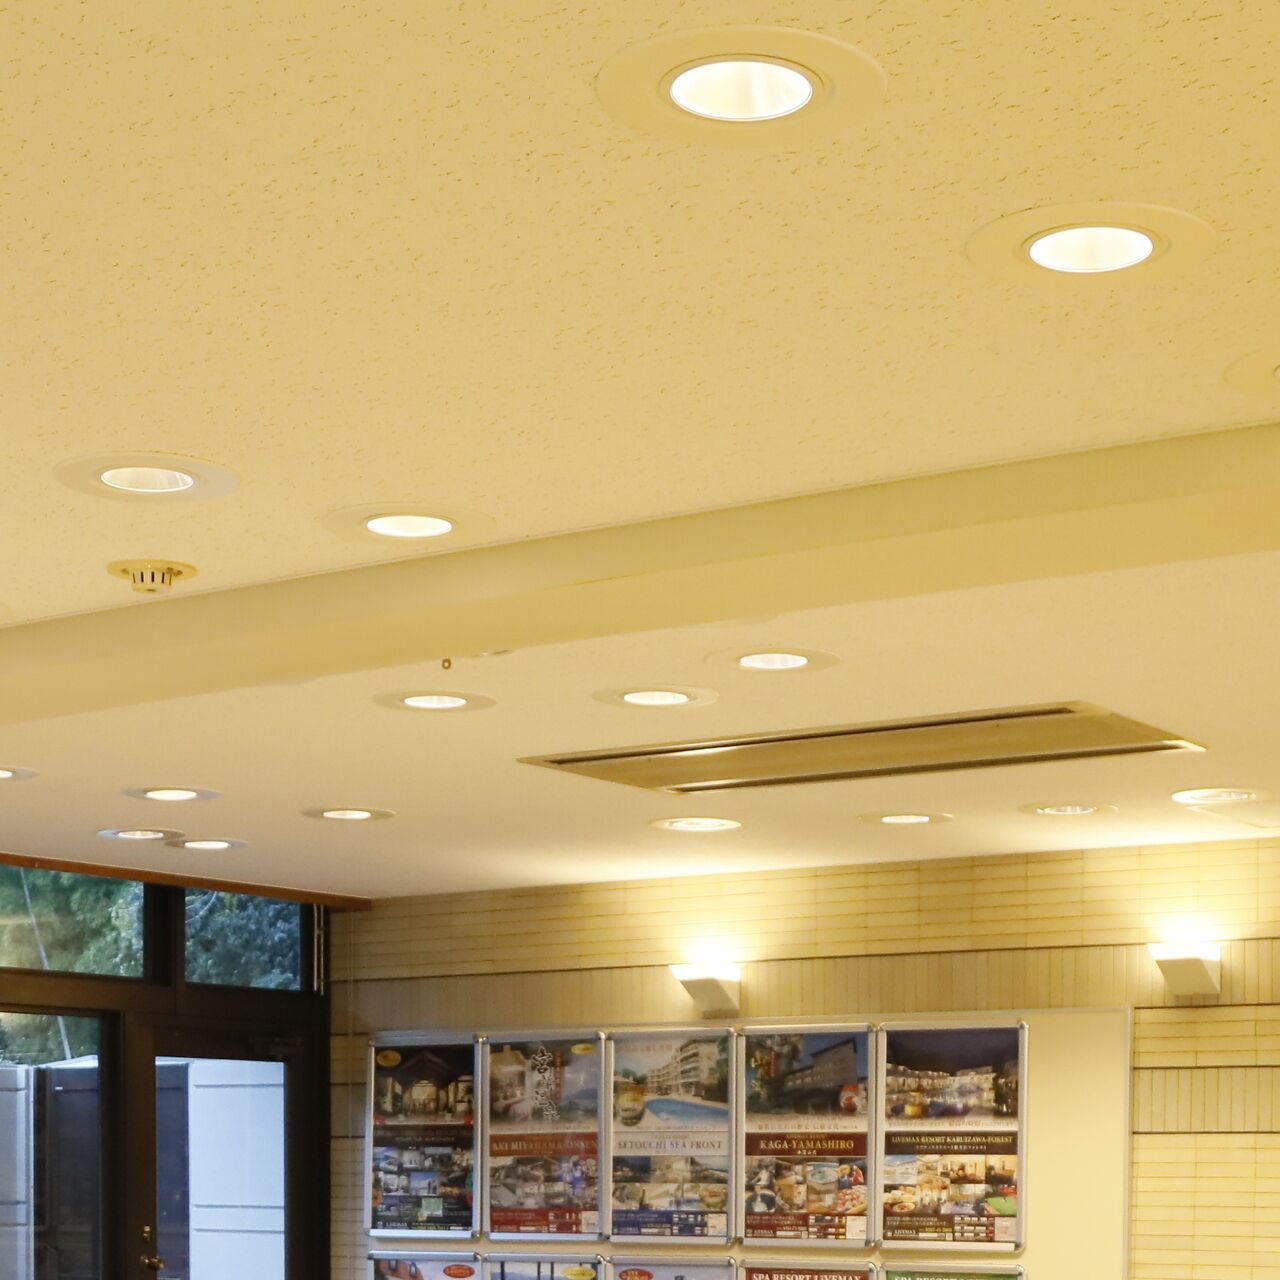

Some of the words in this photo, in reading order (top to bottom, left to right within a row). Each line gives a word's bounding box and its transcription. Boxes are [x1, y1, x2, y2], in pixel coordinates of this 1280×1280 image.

[618, 1140, 666, 1149] SETOUCHI
[670, 1140, 686, 1149] SEA
[690, 1140, 722, 1149] FRONT
[760, 1139, 854, 1150] KAGA-YAMASHIRO
